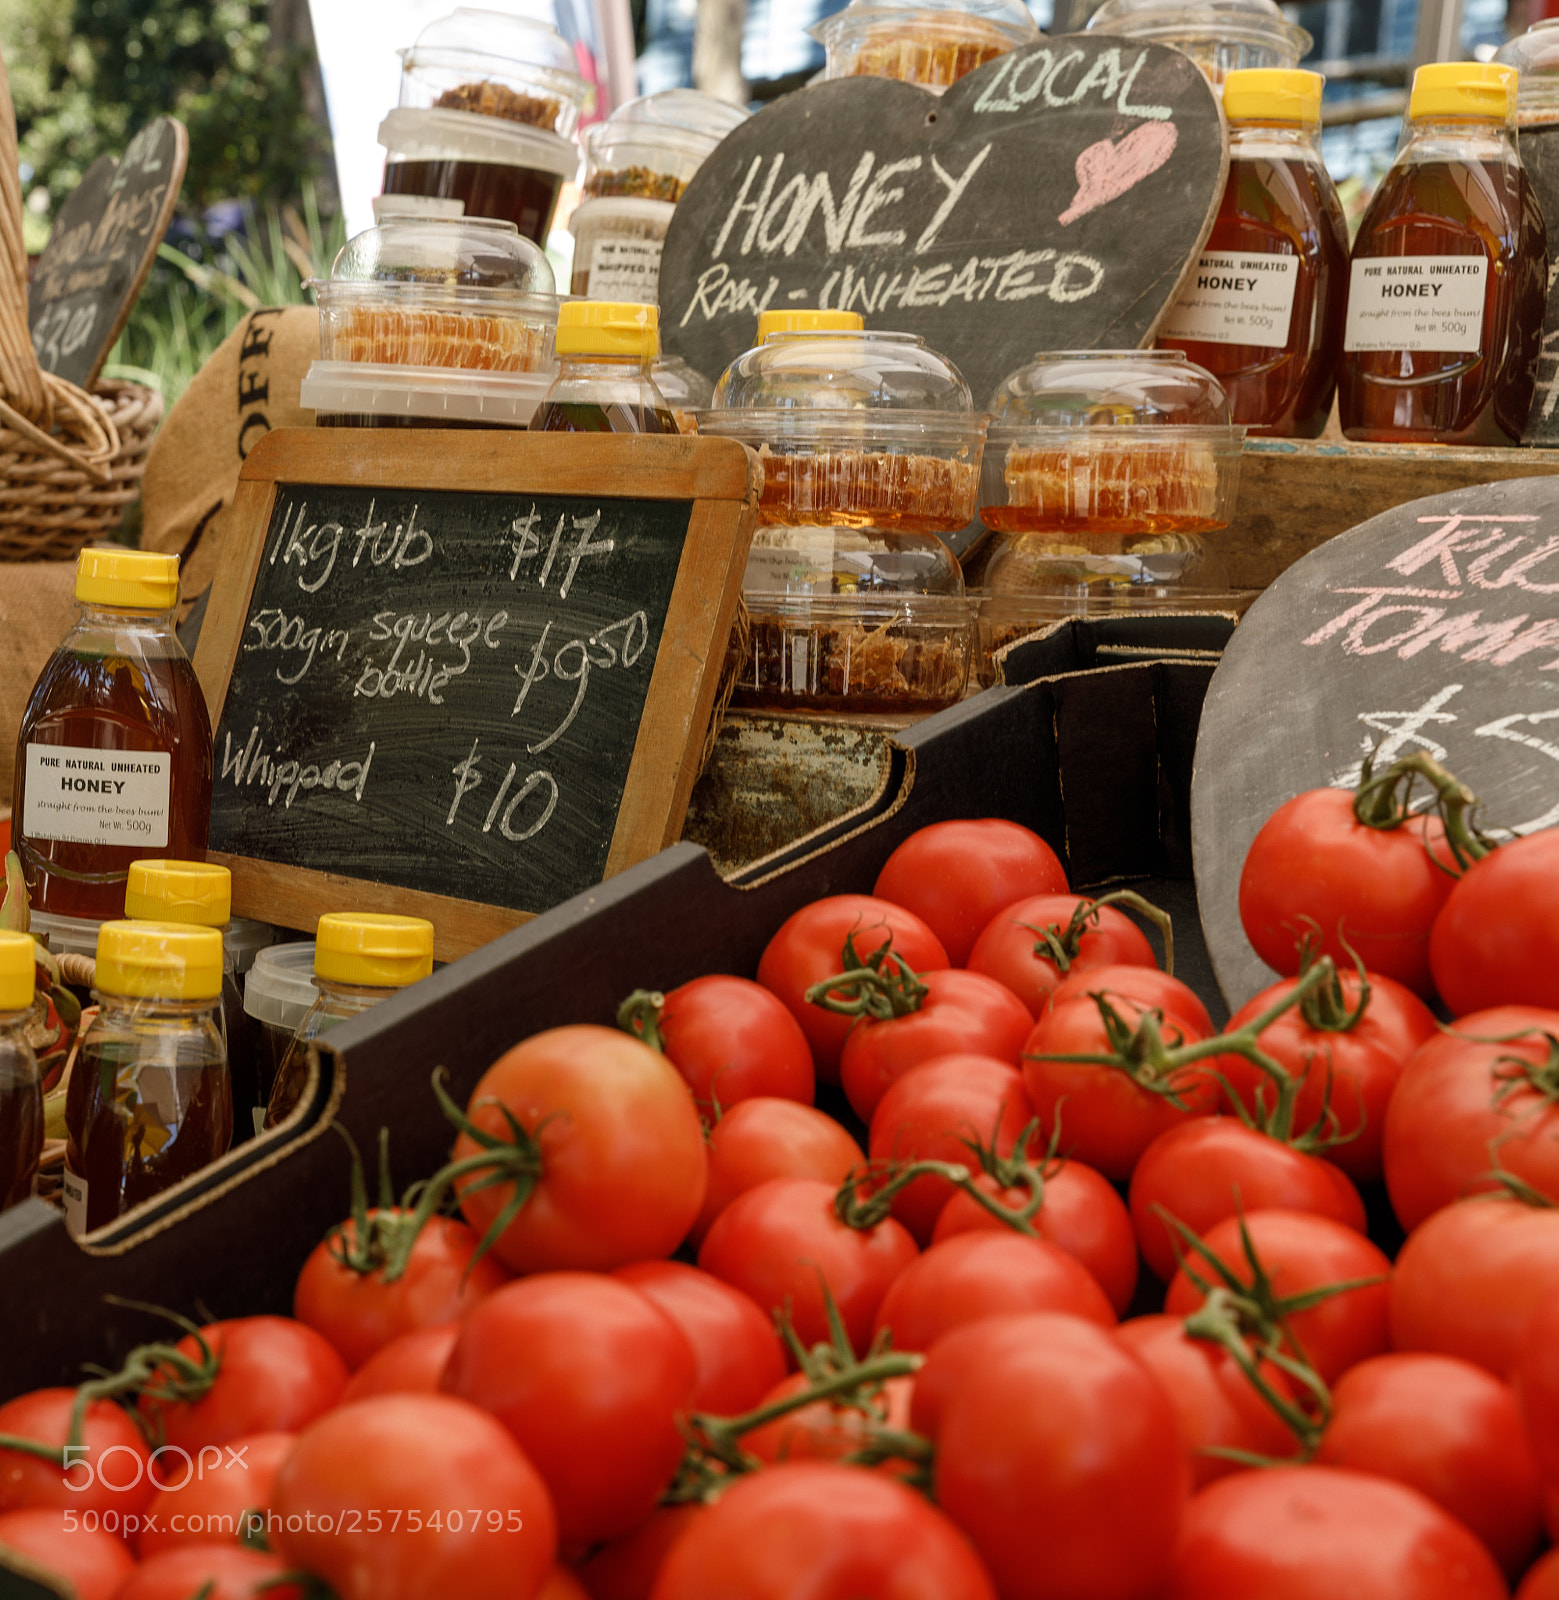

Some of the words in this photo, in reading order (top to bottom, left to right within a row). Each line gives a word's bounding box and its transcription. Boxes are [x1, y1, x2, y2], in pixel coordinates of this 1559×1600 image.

[974, 47, 1172, 121] LOCAL
[711, 142, 992, 260] HONEY
[1199, 258, 1235, 270] NATURAL
[1240, 261, 1288, 272] UNHEATED
[1364, 266, 1383, 277] PURE
[1387, 265, 1424, 276] NATURAL
[1429, 265, 1480, 275] UNHEATED
[680, 262, 780, 328] RAW
[819, 247, 1105, 314] UNHEATED
[1197, 276, 1258, 292] HONEY
[1381, 283, 1444, 298] HONEY
[1414, 306, 1429, 317] the
[1432, 307, 1452, 318] bees
[1249, 315, 1274, 330] 500g
[1415, 324, 1428, 333] Net
[1441, 322, 1467, 335] 500g
[270, 501, 344, 593] 1kg
[353, 498, 434, 570] tub
[510, 502, 615, 599] $17
[369, 610, 508, 676] squeeze
[353, 650, 450, 705] bottle
[40, 756, 61, 768] PURE
[65, 759, 105, 772] NATURAL
[111, 762, 161, 774] UNHEATED
[61, 777, 126, 795] HONEY
[221, 725, 376, 809] Whipped
[445, 737, 560, 841] $10
[37, 800, 71, 813] straight
[73, 803, 96, 814] from
[97, 804, 113, 814] the
[115, 805, 136, 816] bees
[138, 806, 164, 817] bum!
[99, 820, 111, 829] Net
[126, 820, 152, 835] 500g
